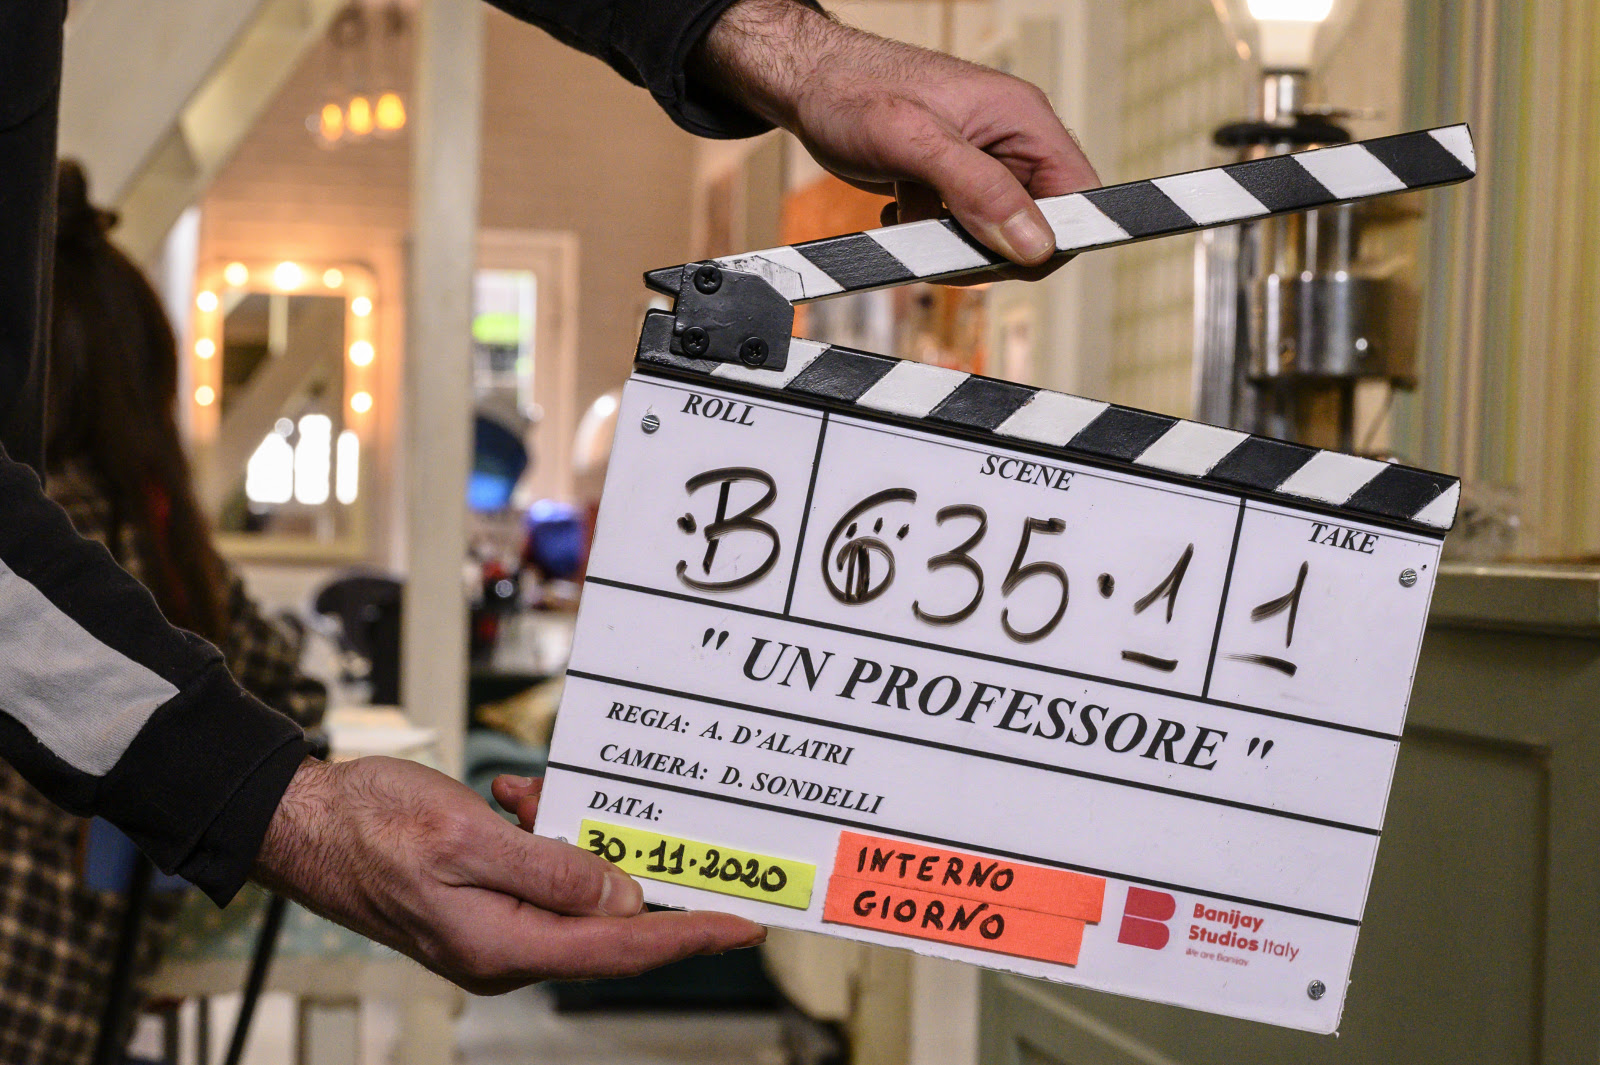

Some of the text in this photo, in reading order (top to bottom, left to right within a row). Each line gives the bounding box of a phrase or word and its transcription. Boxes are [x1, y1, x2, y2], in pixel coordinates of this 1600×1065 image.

[680, 393, 756, 427] ROLL
[980, 454, 1076, 491] SCENE
[676, 466, 781, 592] B
[1307, 522, 1379, 555] TAKE
[606, 701, 690, 733] REGIA:
[699, 720, 723, 741] A.
[836, 656, 1229, 771] PROFESSORE
[599, 743, 885, 815] CAMERA: D. SONDELLI
[587, 790, 663, 822] DATA:
[857, 846, 1014, 892] INTERNO
[853, 890, 1005, 940] GIORNO
[1193, 903, 1264, 933] Banijay
[1188, 925, 1300, 962] Studios Italy
[1200, 950, 1216, 961] are
[1216, 950, 1249, 967] Banijay
